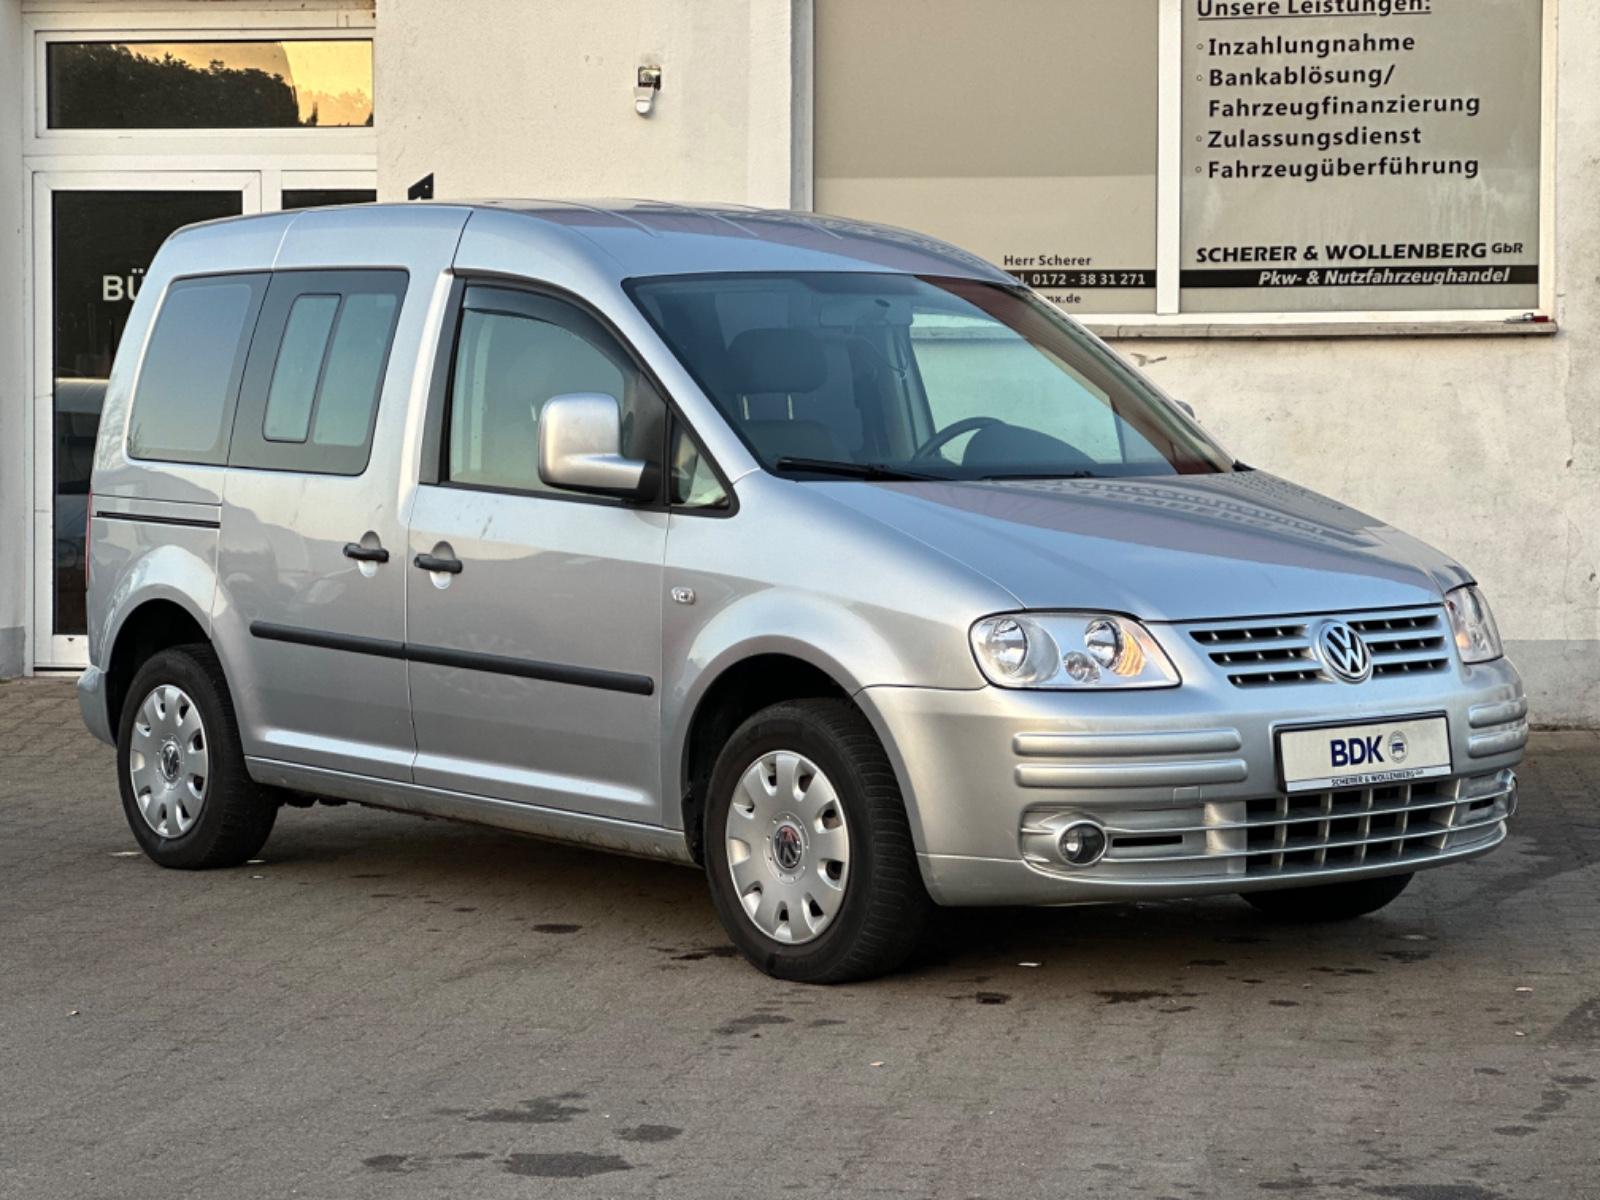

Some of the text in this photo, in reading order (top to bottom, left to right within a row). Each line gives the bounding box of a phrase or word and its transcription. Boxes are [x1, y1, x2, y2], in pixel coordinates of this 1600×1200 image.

[1197, 0, 1431, 17] Unsere Leistungen:
[1208, 33, 1416, 58] Inzahlungnahme
[1208, 64, 1396, 88] Bankablösung/
[1208, 94, 1481, 119] Fahrzeugfinanzierung
[1207, 126, 1422, 150] Zulassungsdienst
[1207, 156, 1480, 181] Fahrzeugüberführung
[1004, 254, 1091, 266] Herr Scherer
[1196, 242, 1523, 263] SCHERER & WOLLENBERG GbR
[1032, 273, 1066, 285] 0172
[1080, 273, 1096, 285] 38
[1100, 273, 1116, 285] 31
[1120, 273, 1145, 285] 271
[1258, 267, 1510, 286] Pkw- & Nutzfahrzeughandel
[1330, 735, 1384, 767] BDK
